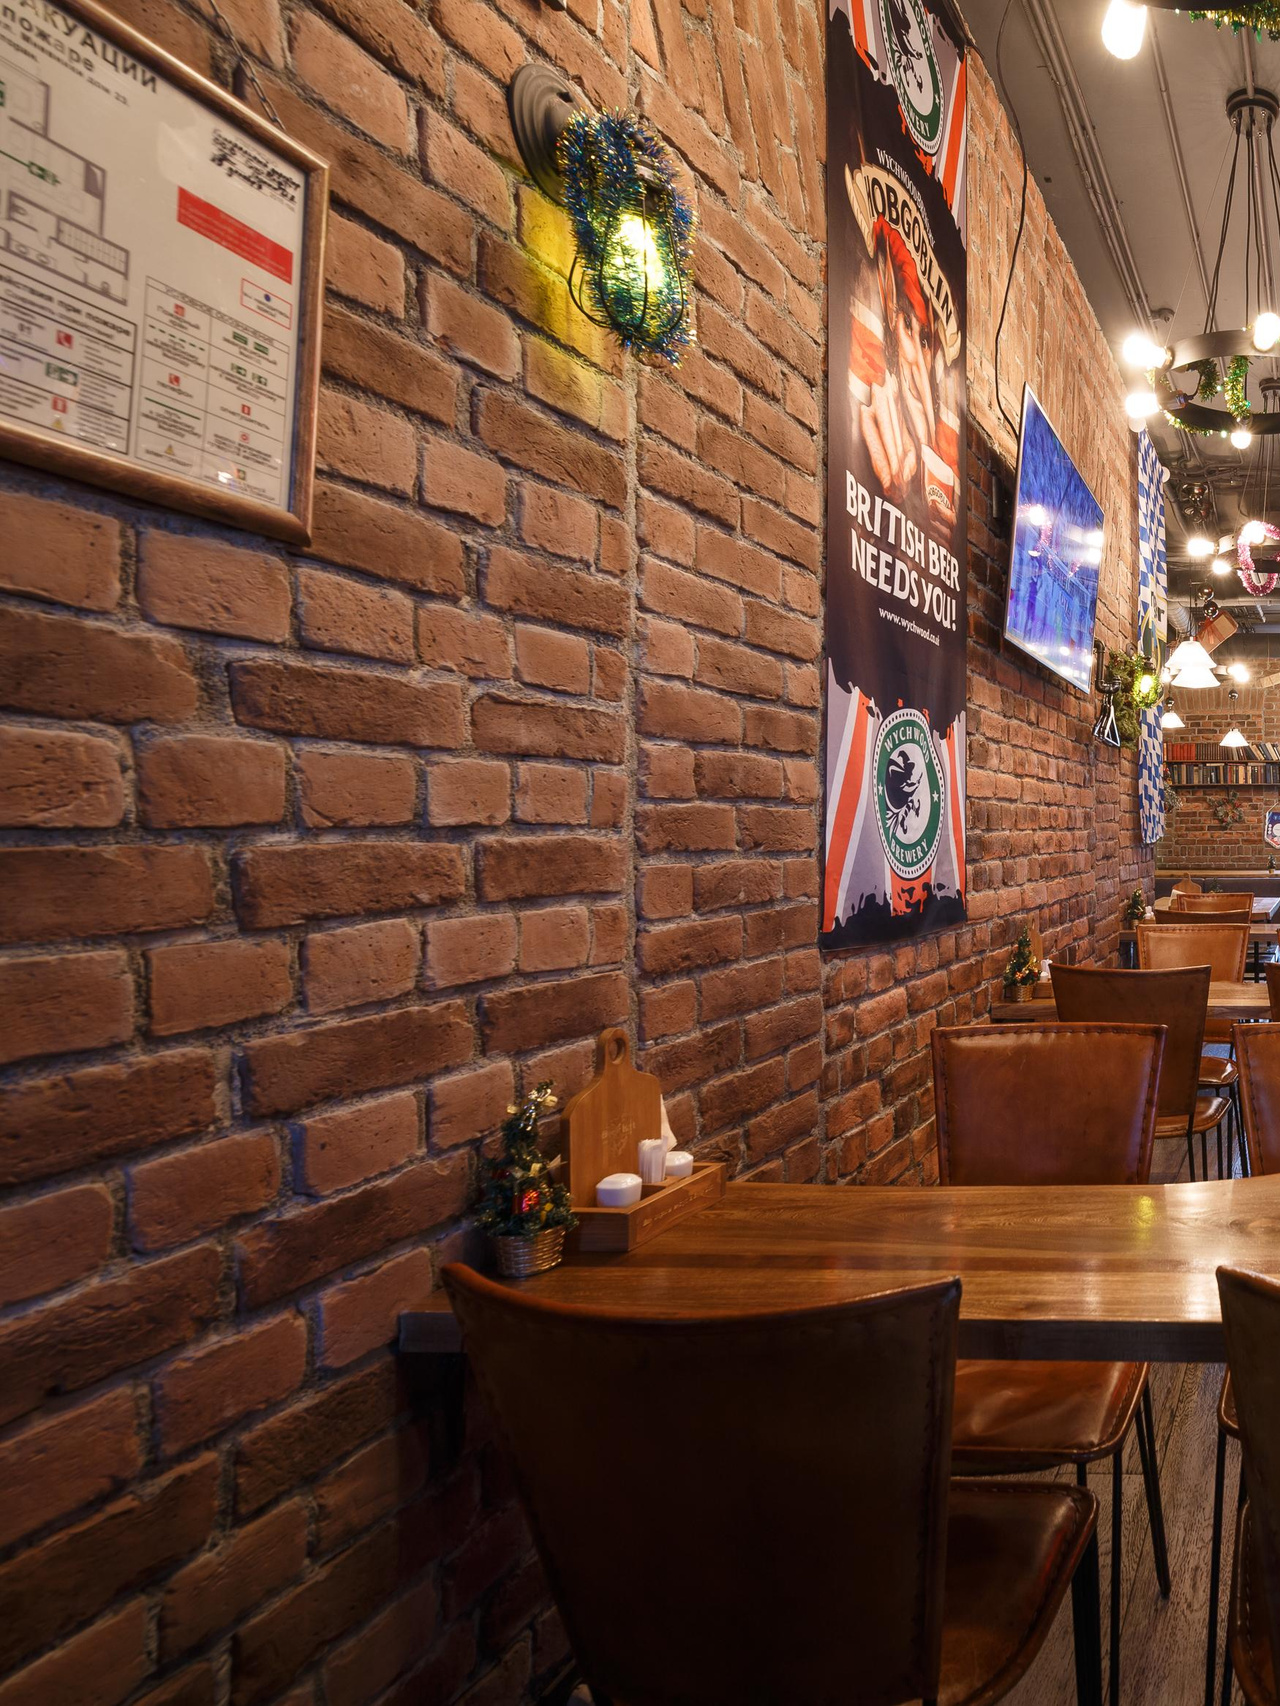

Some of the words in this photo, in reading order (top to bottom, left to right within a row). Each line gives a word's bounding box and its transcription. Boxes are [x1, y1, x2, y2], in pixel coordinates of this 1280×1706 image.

[864, 174, 953, 326] HOBGOBLIN
[846, 470, 926, 569] BRITISH
[928, 539, 961, 592] BEER
[851, 528, 919, 608] NEEDS
[920, 577, 957, 632] YOU!
[884, 726, 930, 764] WYCHWOOD
[890, 838, 928, 864] BREWERY
